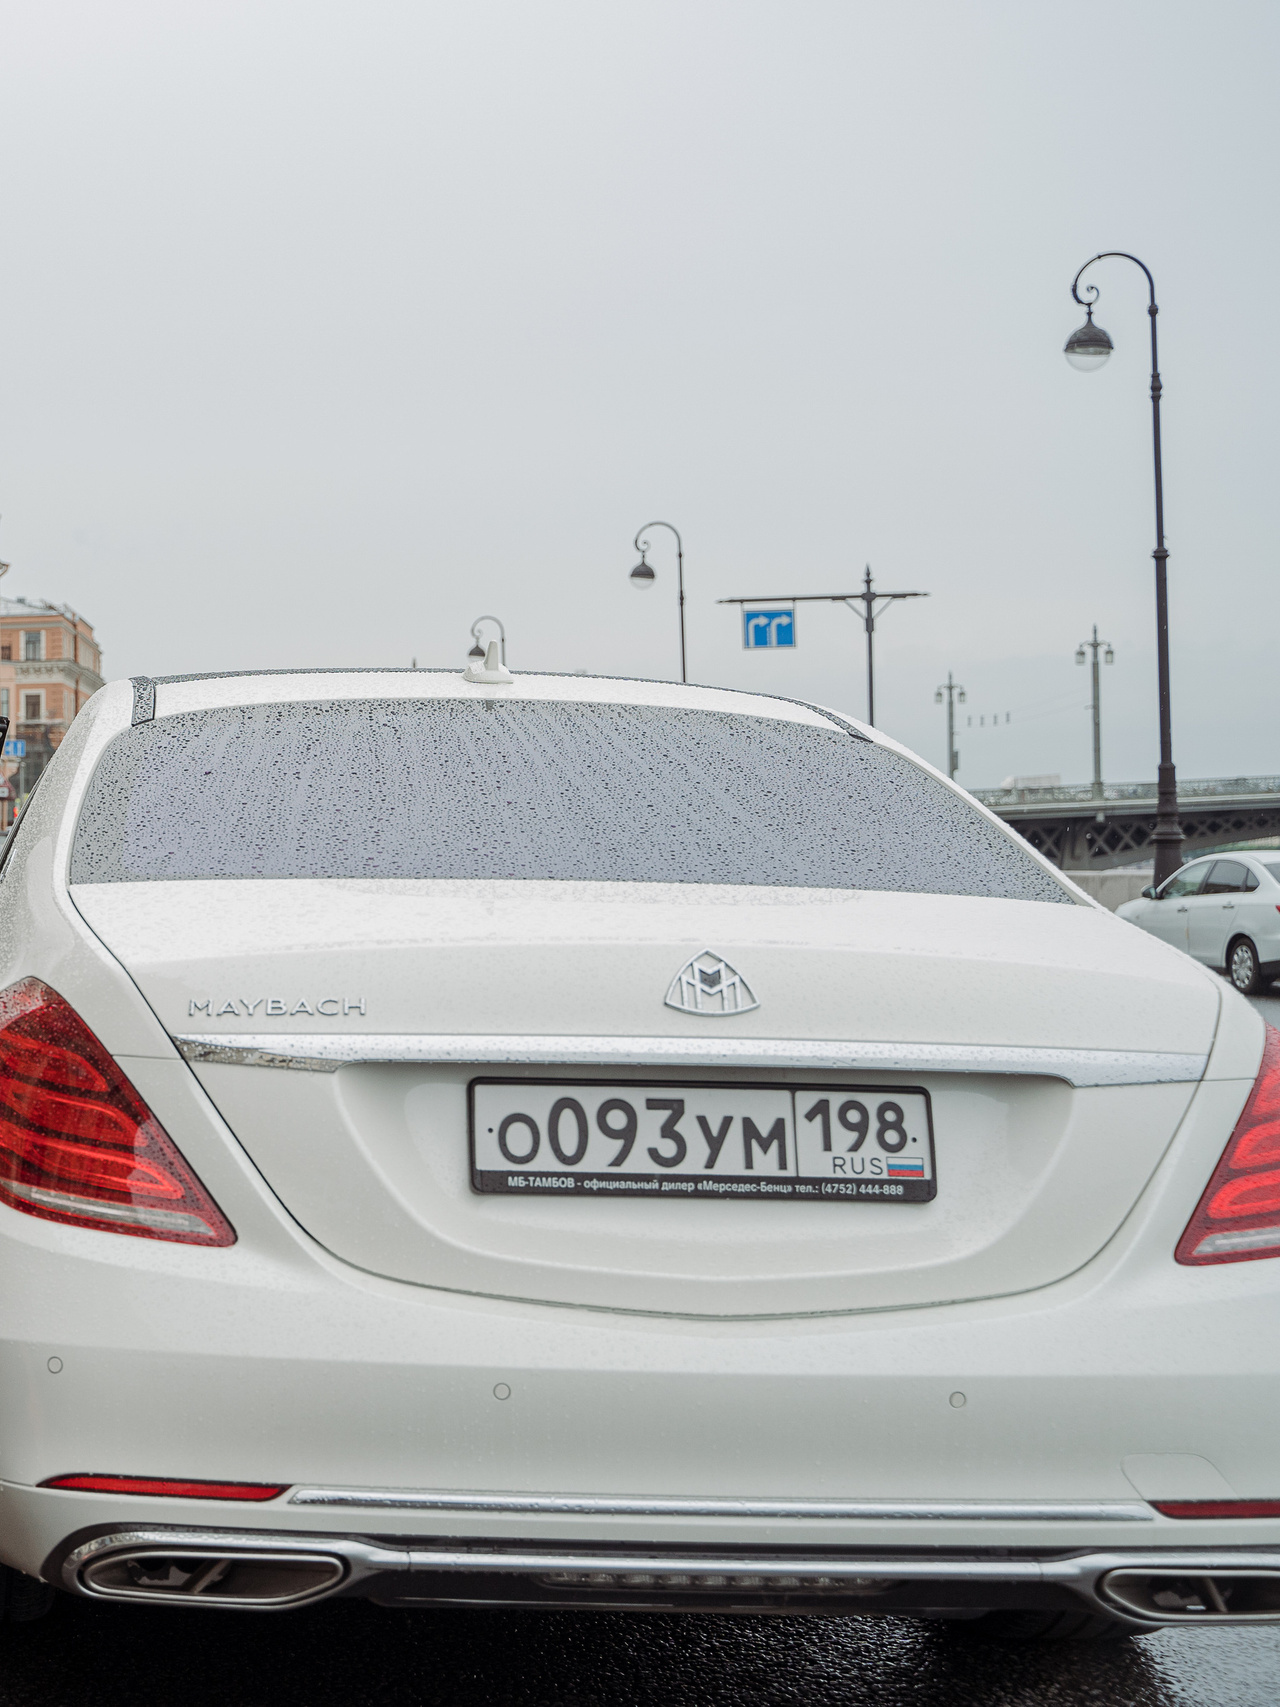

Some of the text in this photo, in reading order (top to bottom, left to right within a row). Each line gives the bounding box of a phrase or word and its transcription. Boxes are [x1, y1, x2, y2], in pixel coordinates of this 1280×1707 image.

[188, 997, 367, 1017] MAYBACH
[804, 1098, 910, 1154] 198
[832, 1156, 883, 1176] RUS
[507, 1176, 575, 1189] МБ-ТАМБОВ
[583, 1179, 659, 1191] официальный
[661, 1181, 695, 1193] дилер
[696, 1180, 792, 1194] «Мерседес-Бенц»
[794, 1184, 819, 1194] тел.:
[821, 1183, 857, 1195] (4752)
[858, 1184, 904, 1195] 444-888
